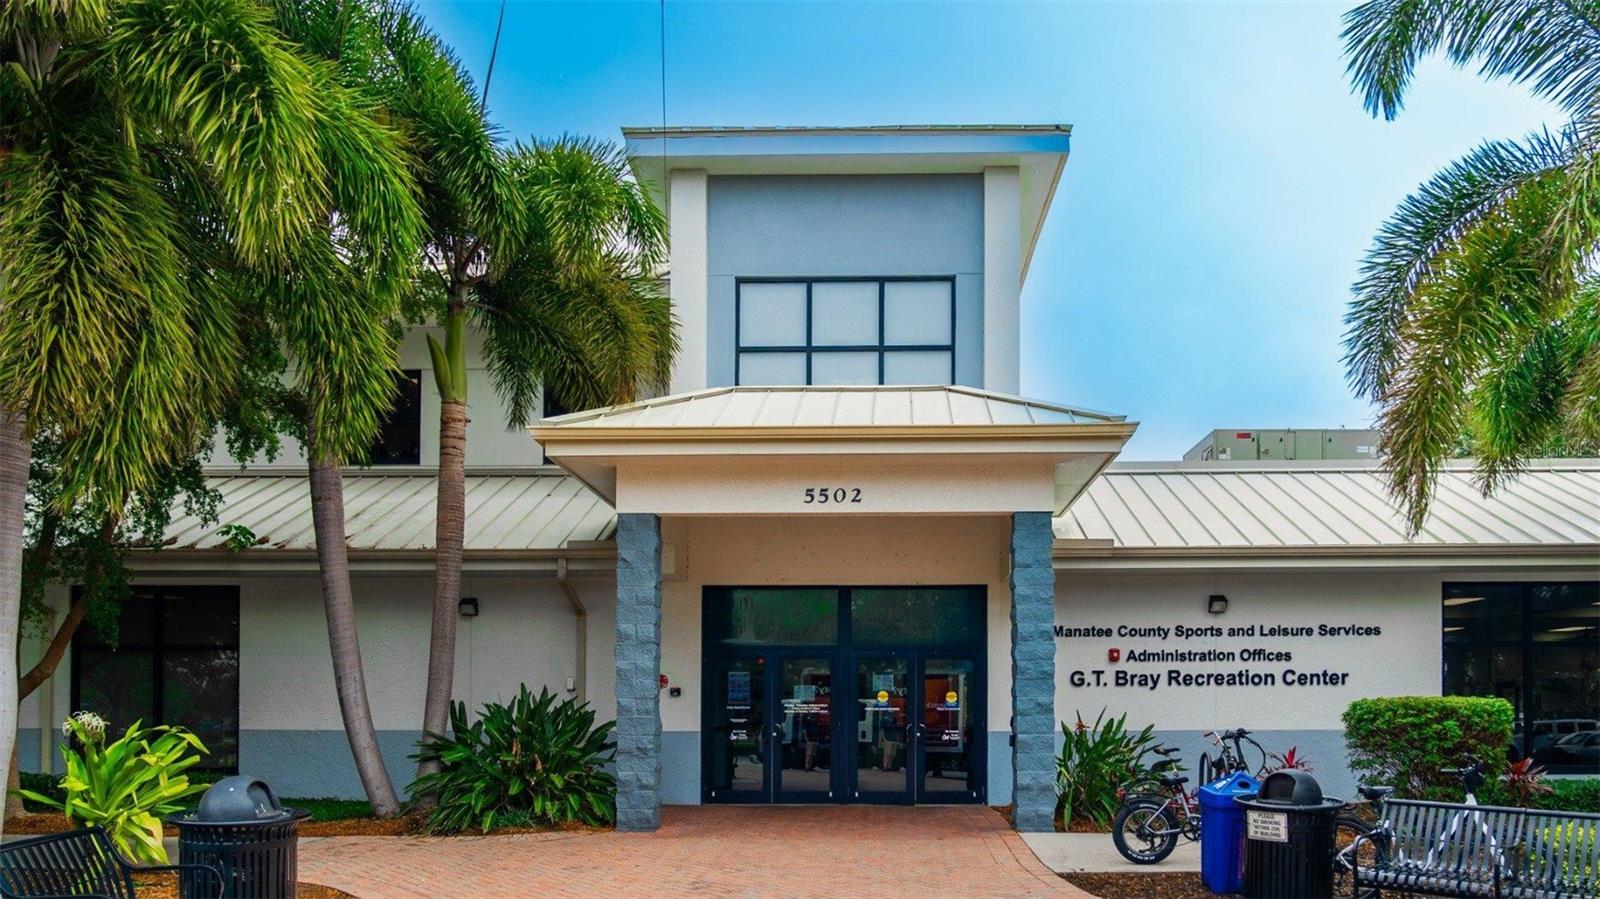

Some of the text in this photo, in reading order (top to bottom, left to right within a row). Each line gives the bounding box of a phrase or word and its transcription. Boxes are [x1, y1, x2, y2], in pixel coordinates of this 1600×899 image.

[804, 487, 863, 504] 5502
[1053, 624, 1382, 640] Manatee County Sports and Leisure Services
[1126, 648, 1292, 663] Administration Offices
[1070, 669, 1349, 690] G.T. Bray Recreation Center
